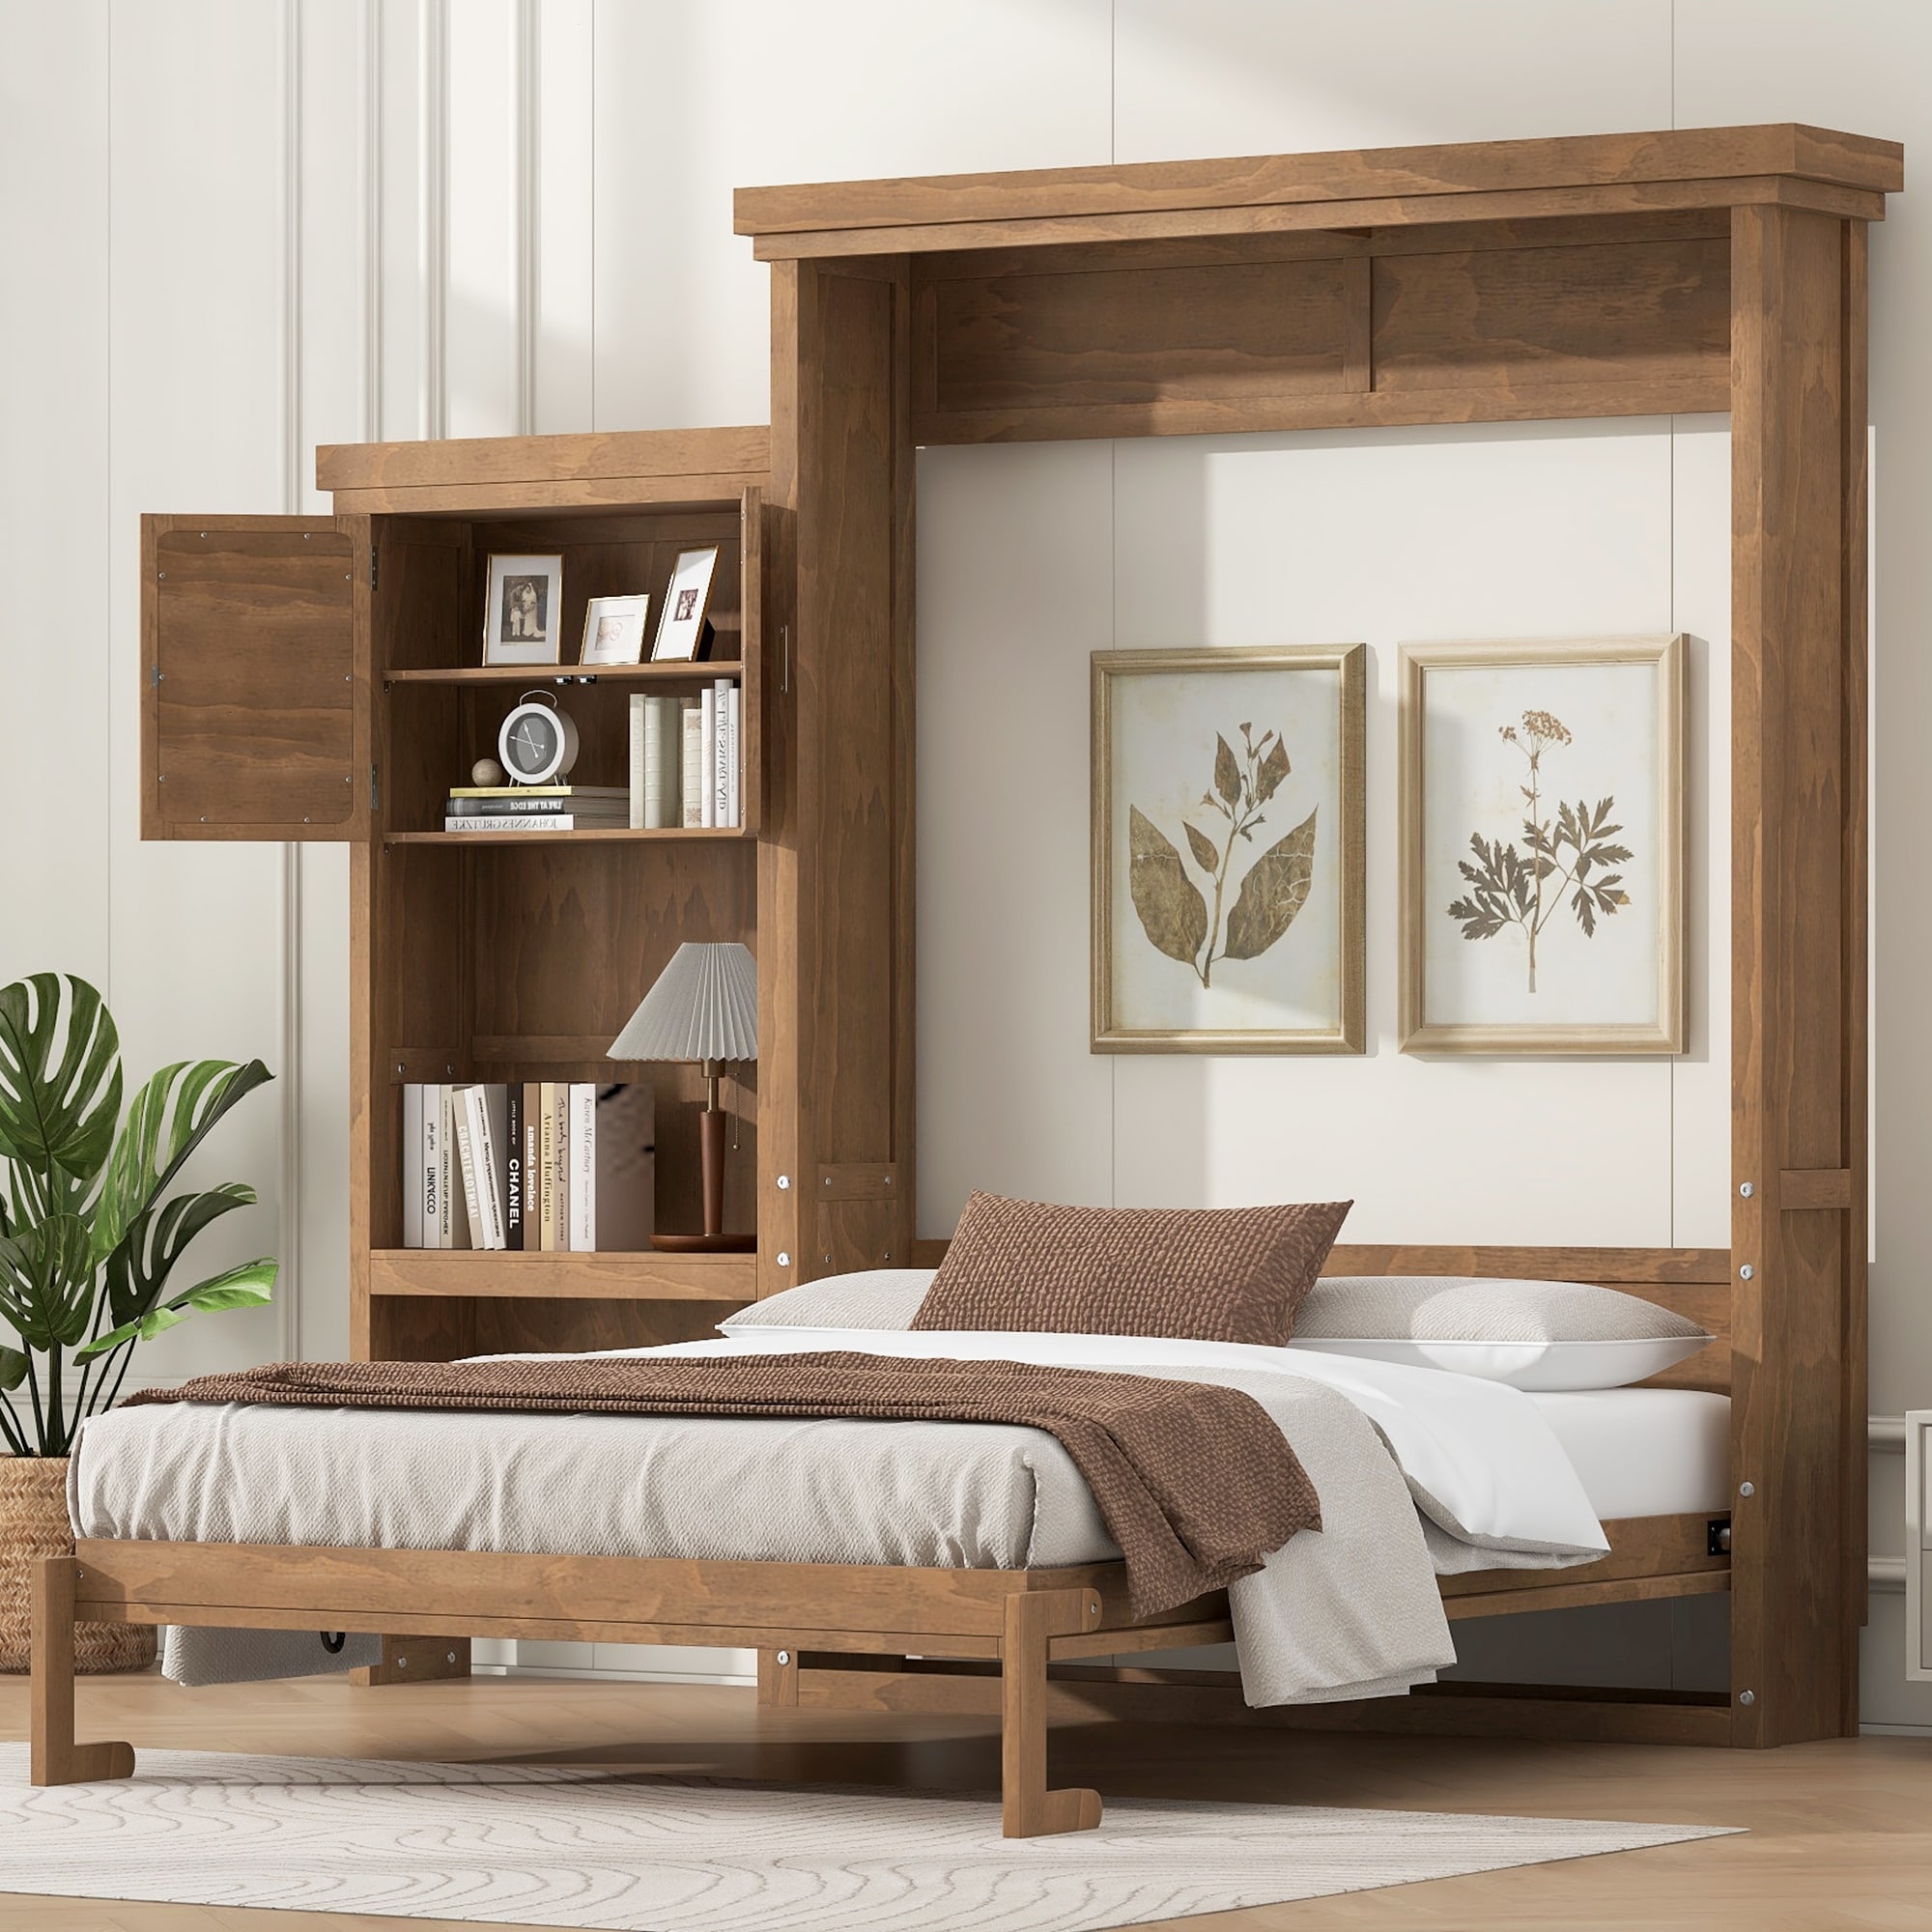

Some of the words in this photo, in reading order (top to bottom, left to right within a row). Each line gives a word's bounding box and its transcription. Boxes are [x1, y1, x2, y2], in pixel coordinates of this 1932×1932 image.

[583, 1097, 592, 1123] Karen
[527, 1125, 536, 1167] amanda
[544, 1113, 553, 1156] Arianna
[582, 1126, 592, 1173] McCartney
[458, 1125, 472, 1172] СПАСИТЕ
[465, 1173, 479, 1217] КОТИКА!
[527, 1169, 536, 1211] lovelace
[542, 1161, 553, 1222] Huffington
[509, 1159, 520, 1229] CHANEL
